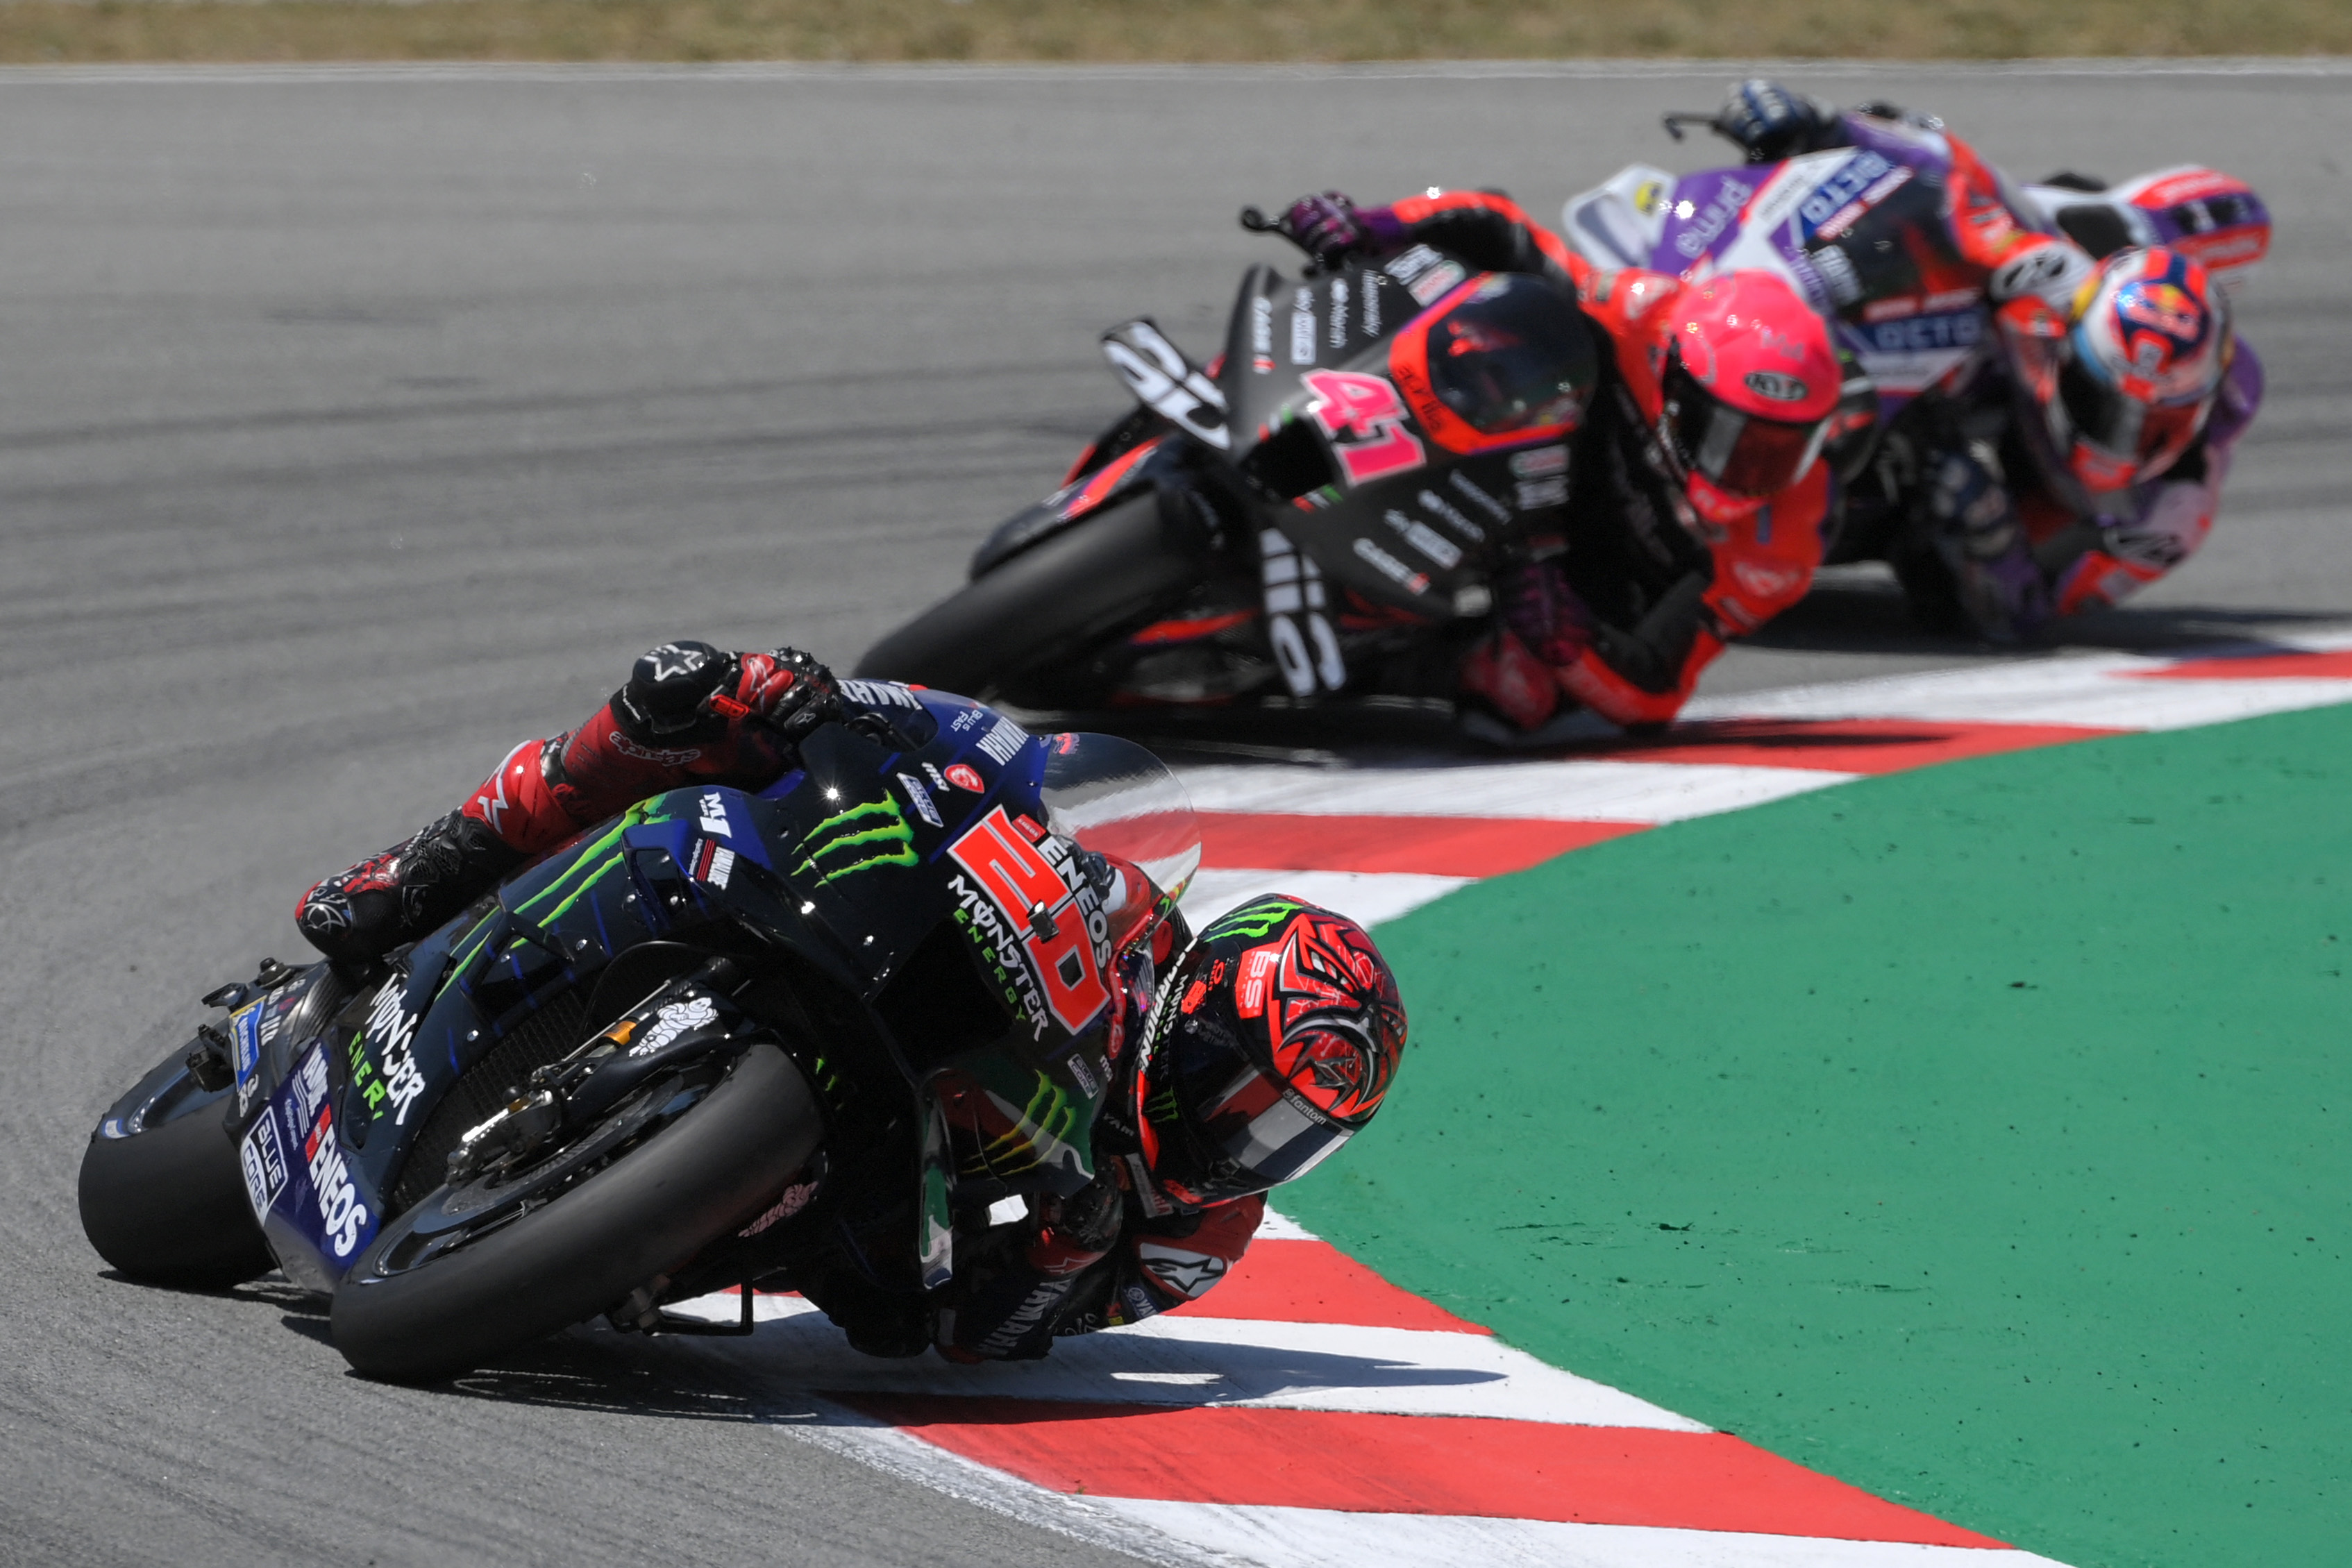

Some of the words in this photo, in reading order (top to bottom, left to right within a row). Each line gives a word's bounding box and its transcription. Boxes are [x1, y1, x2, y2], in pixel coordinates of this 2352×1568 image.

[1300, 367, 1427, 489] 41
[975, 716, 1030, 766] YAMAHA
[699, 791, 732, 839] M1
[946, 803, 1111, 1036] 20
[947, 874, 1049, 1042] MONSTER
[1037, 836, 1111, 969] ENEOS
[953, 907, 1026, 1020] ENERGY
[1140, 937, 1198, 1069] ORPION
[1245, 951, 1271, 1009] BS
[348, 1030, 386, 1121] ENER
[364, 972, 426, 1126] MONSER
[244, 1146, 266, 1213] CORE
[257, 1119, 282, 1190] BLUE
[309, 1123, 367, 1257] ENEOS
